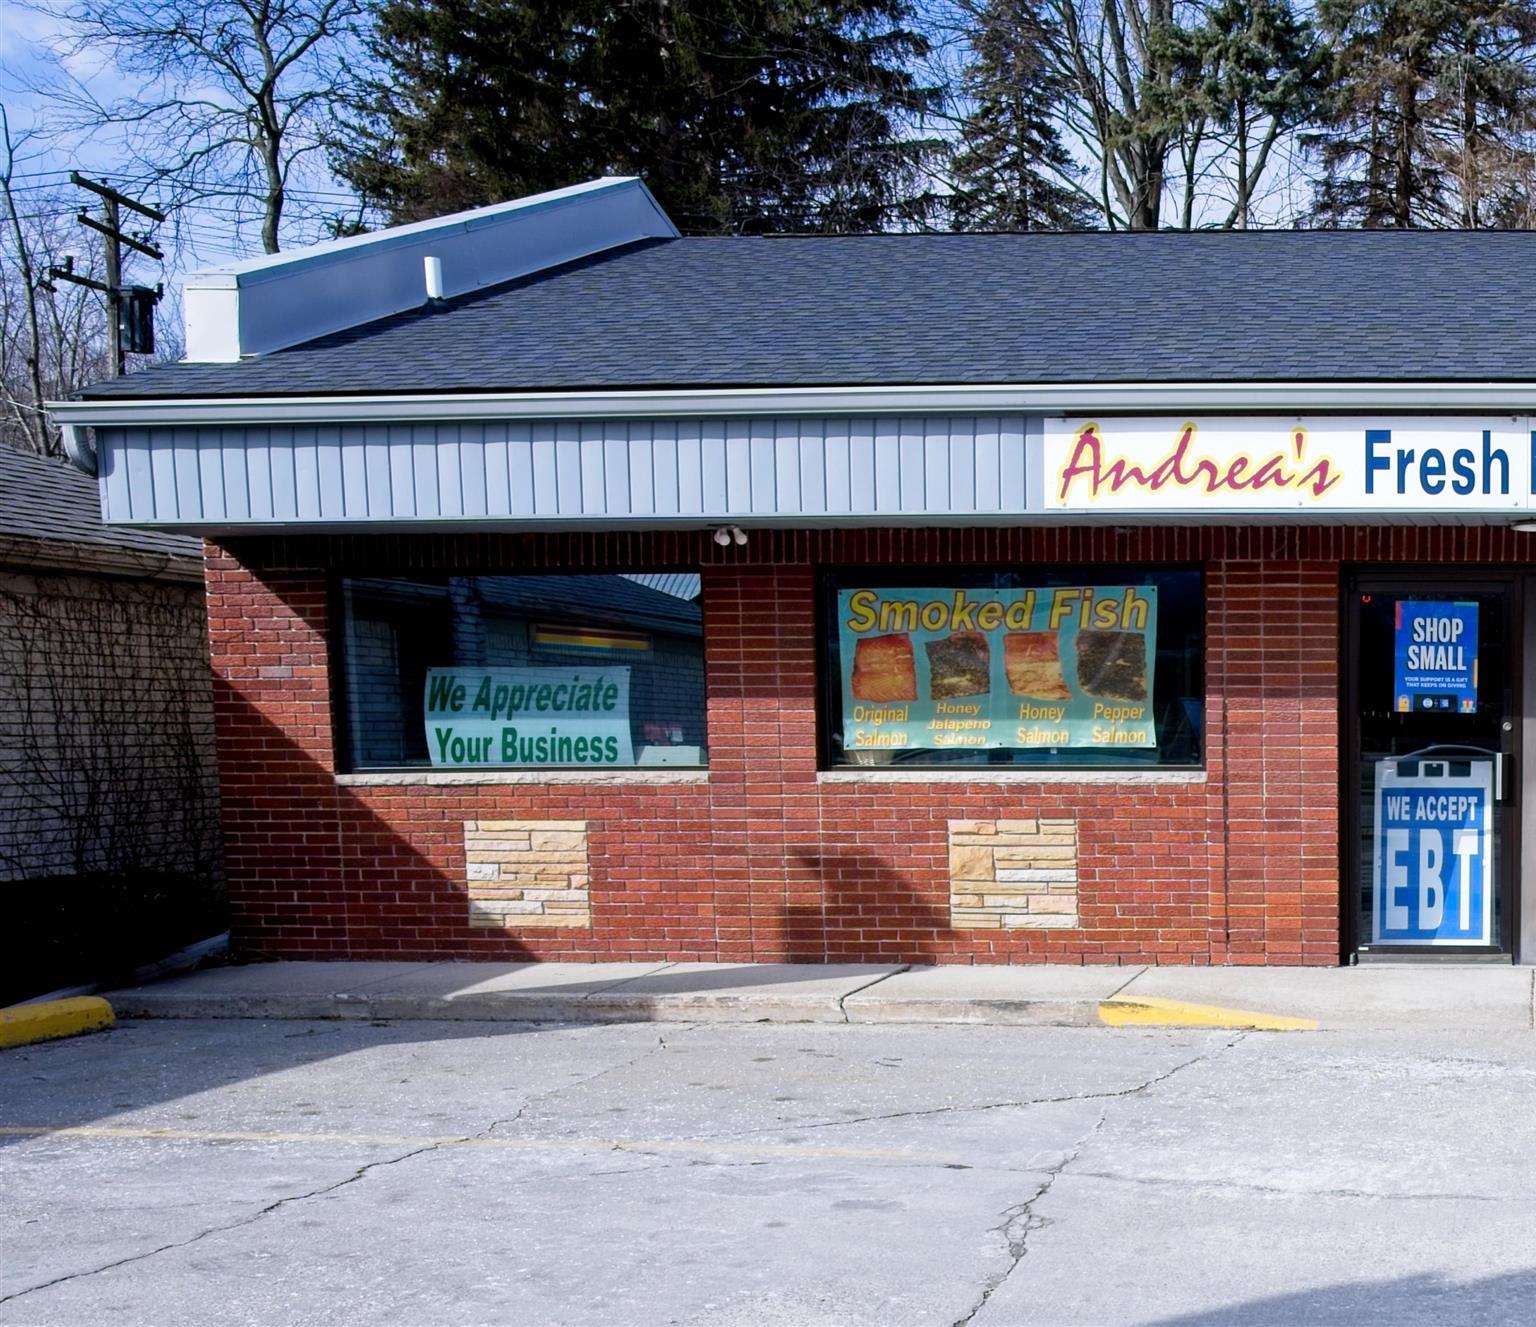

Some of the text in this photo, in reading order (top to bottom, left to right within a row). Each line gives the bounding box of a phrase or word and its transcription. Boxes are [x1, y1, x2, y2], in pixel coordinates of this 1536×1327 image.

[1058, 425, 1341, 499] Andrea's
[1364, 429, 1510, 495] Fresh
[847, 588, 1149, 632] Smoked Fish
[1412, 617, 1463, 643] SHOP
[1407, 646, 1467, 671] SMALL
[428, 676, 618, 720] We Appreciate
[853, 705, 909, 726] Original
[936, 702, 983, 716] Honey
[1020, 704, 1065, 724] Honey
[1094, 703, 1145, 722] Pepper
[928, 719, 991, 732] Jalapeno
[1016, 727, 1070, 745] Salmon
[1091, 726, 1146, 744] Salmon
[435, 727, 618, 763] Your Business
[856, 729, 908, 747] Salmon
[934, 734, 986, 746] Salmon
[1387, 796, 1477, 821] WE ACCEPT
[1385, 828, 1479, 931] EBT
